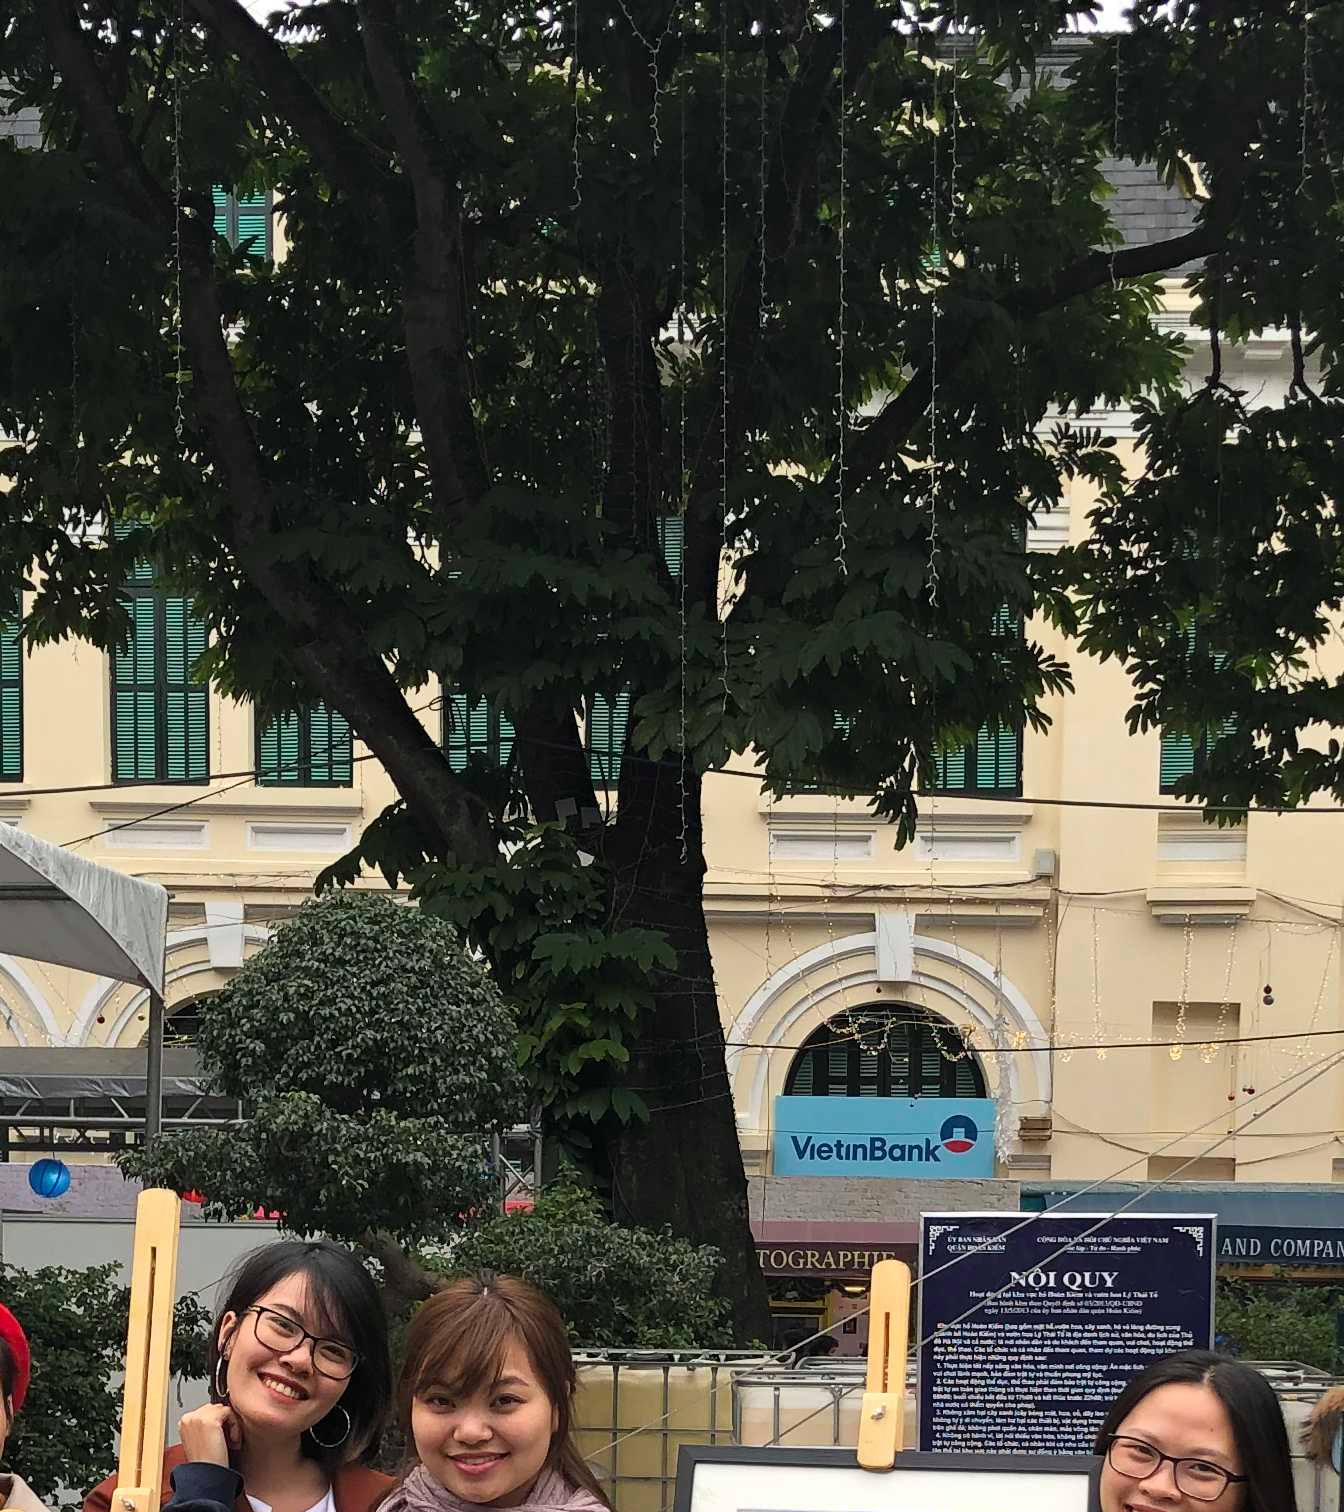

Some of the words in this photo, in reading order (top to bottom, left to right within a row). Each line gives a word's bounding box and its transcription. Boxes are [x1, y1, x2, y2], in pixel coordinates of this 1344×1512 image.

[791, 1135, 941, 1163] VietinBank
[1221, 1238, 1261, 1256] AND
[1009, 1267, 1057, 1290] NỘI
[1062, 1272, 1119, 1291] QUY
